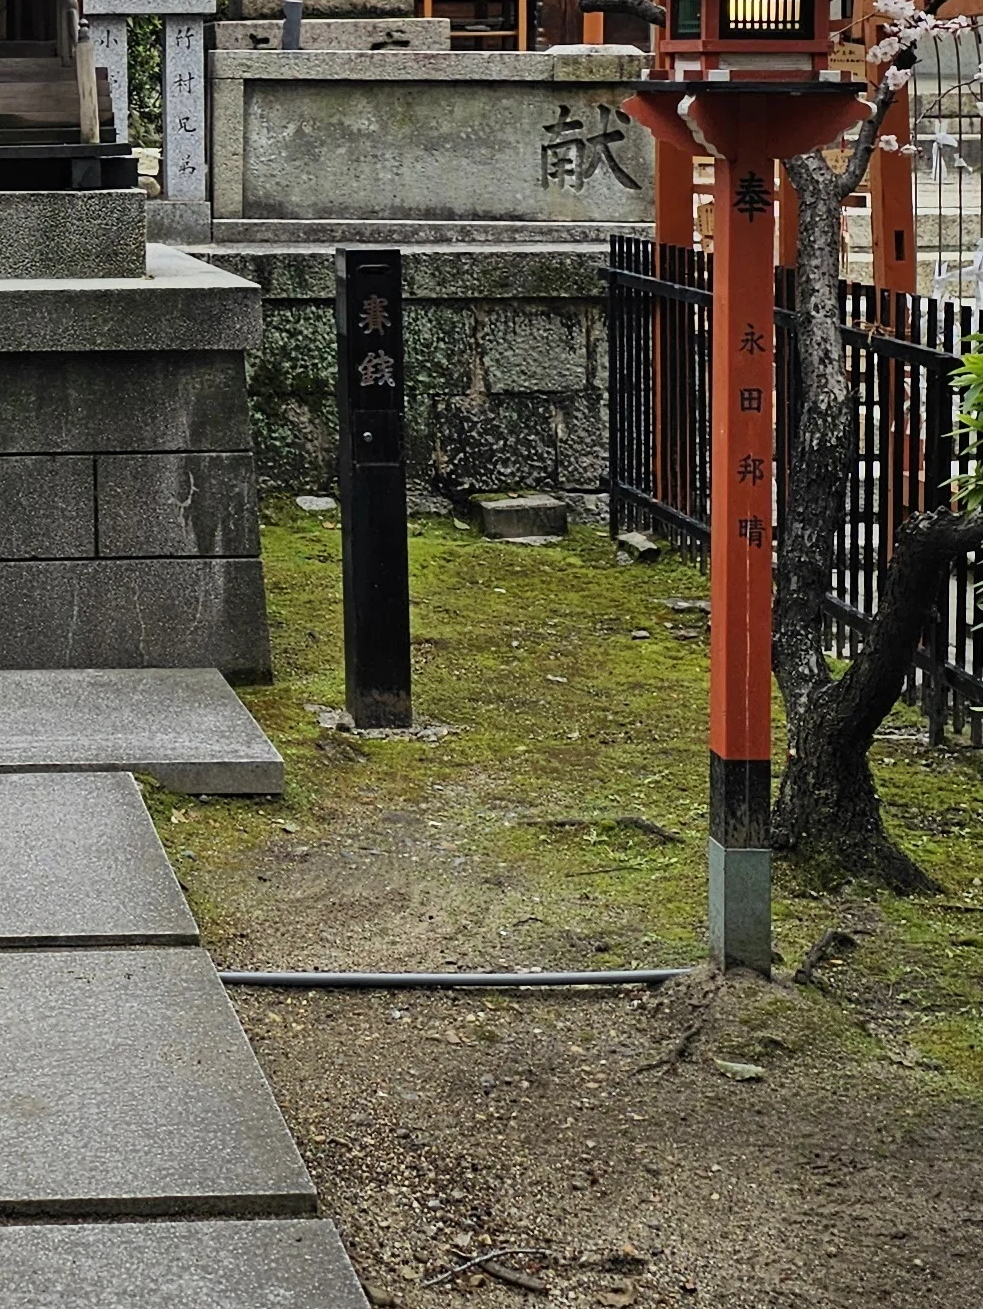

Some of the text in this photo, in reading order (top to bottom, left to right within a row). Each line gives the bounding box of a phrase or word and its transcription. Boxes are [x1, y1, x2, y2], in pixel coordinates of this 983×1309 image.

[541, 103, 643, 193] 献
[733, 171, 772, 223] 奉
[736, 322, 767, 549] 永田邦晴
